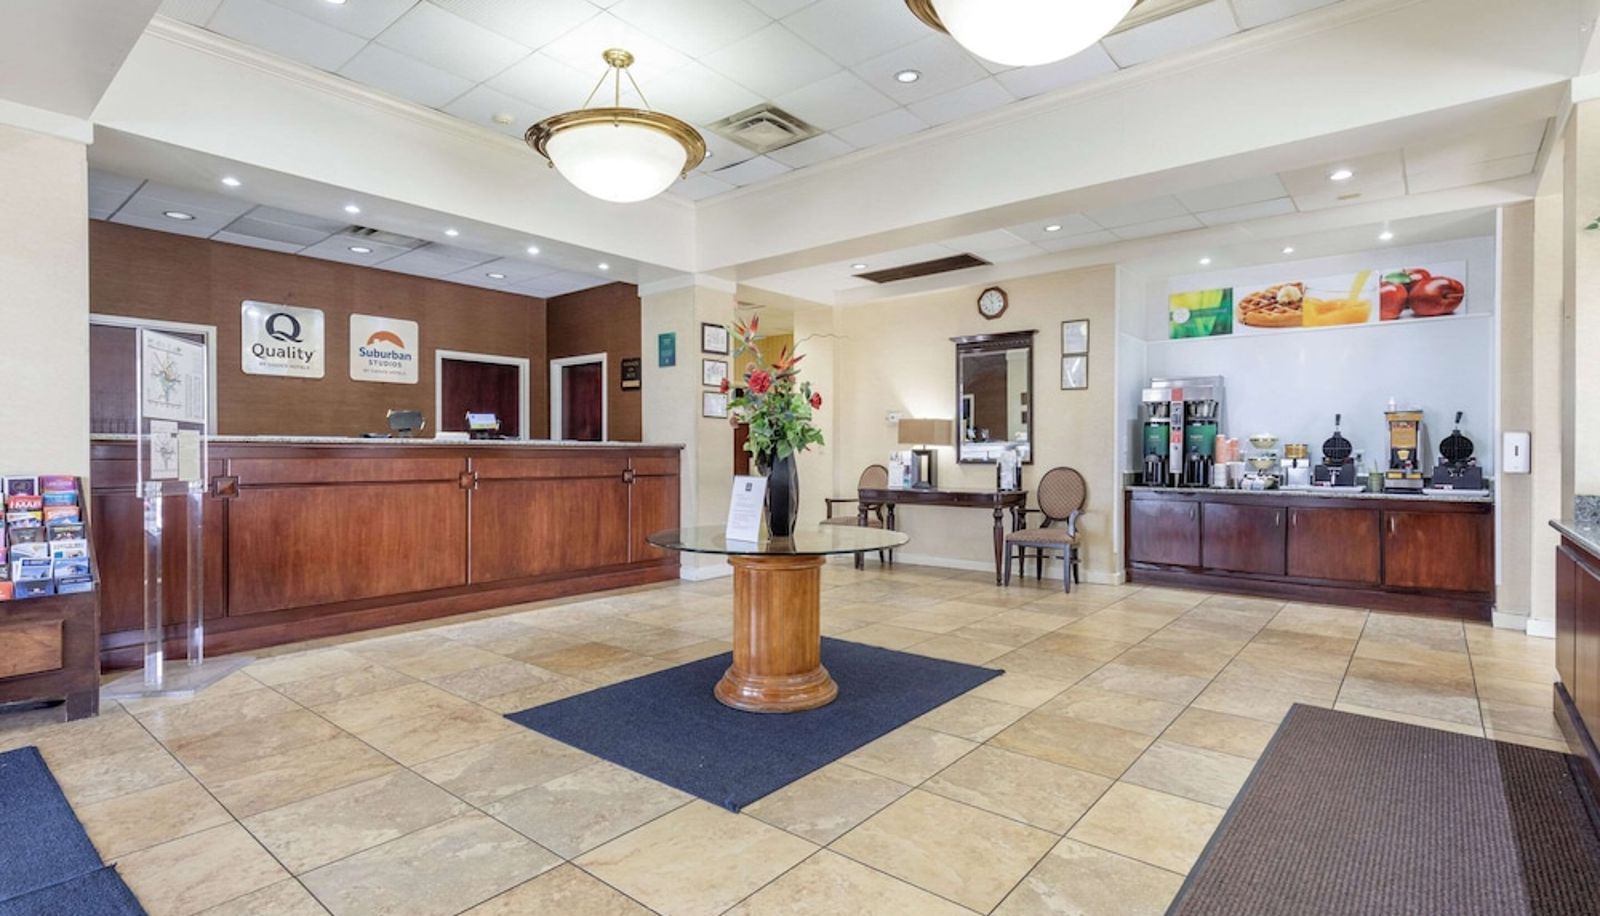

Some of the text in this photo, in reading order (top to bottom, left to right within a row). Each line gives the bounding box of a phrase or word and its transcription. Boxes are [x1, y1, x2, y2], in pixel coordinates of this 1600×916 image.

[265, 312, 303, 343] Q
[252, 343, 313, 363] Quality
[359, 346, 412, 361] Suburban
[369, 359, 402, 368] STUDIOS
